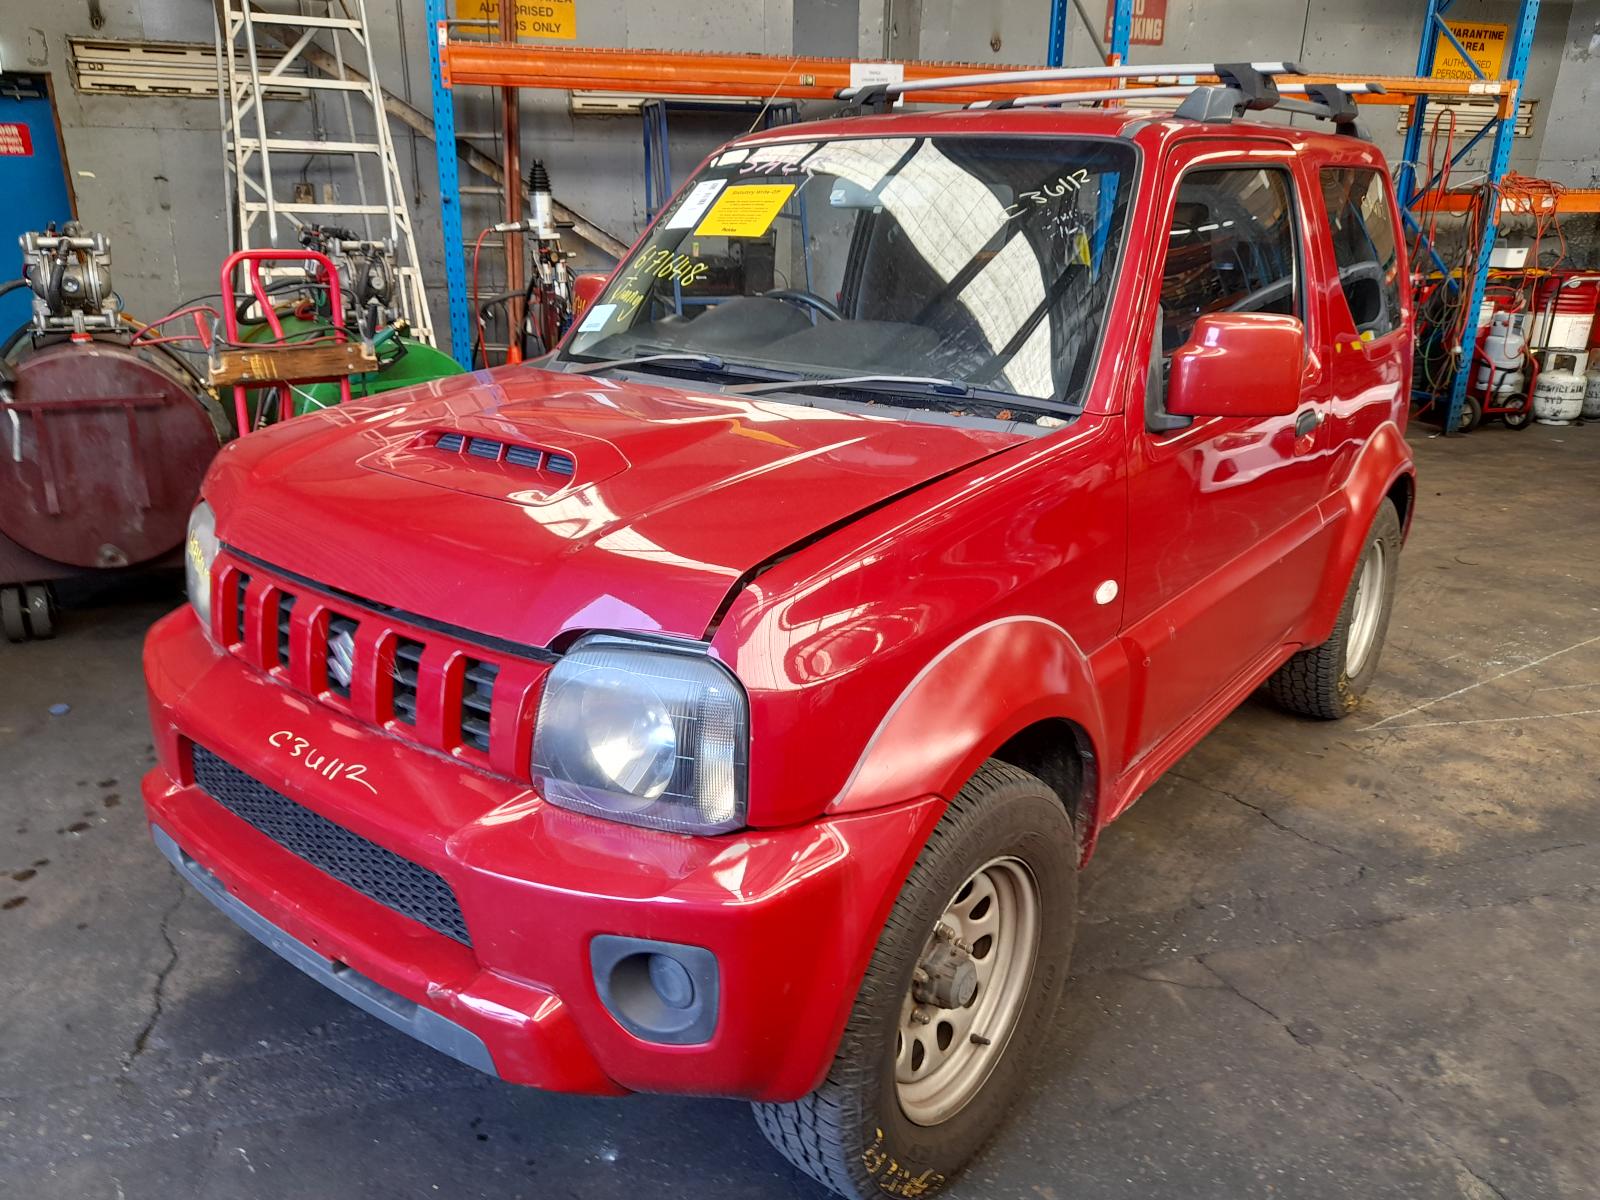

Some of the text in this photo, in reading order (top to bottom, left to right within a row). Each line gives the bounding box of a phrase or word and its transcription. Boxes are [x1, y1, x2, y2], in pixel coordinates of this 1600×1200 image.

[480, 2, 554, 17] AUTRISED
[532, 21, 562, 33] ONLY
[1107, 16, 1162, 40] SKING
[1442, 58, 1492, 69] AUTHOSED
